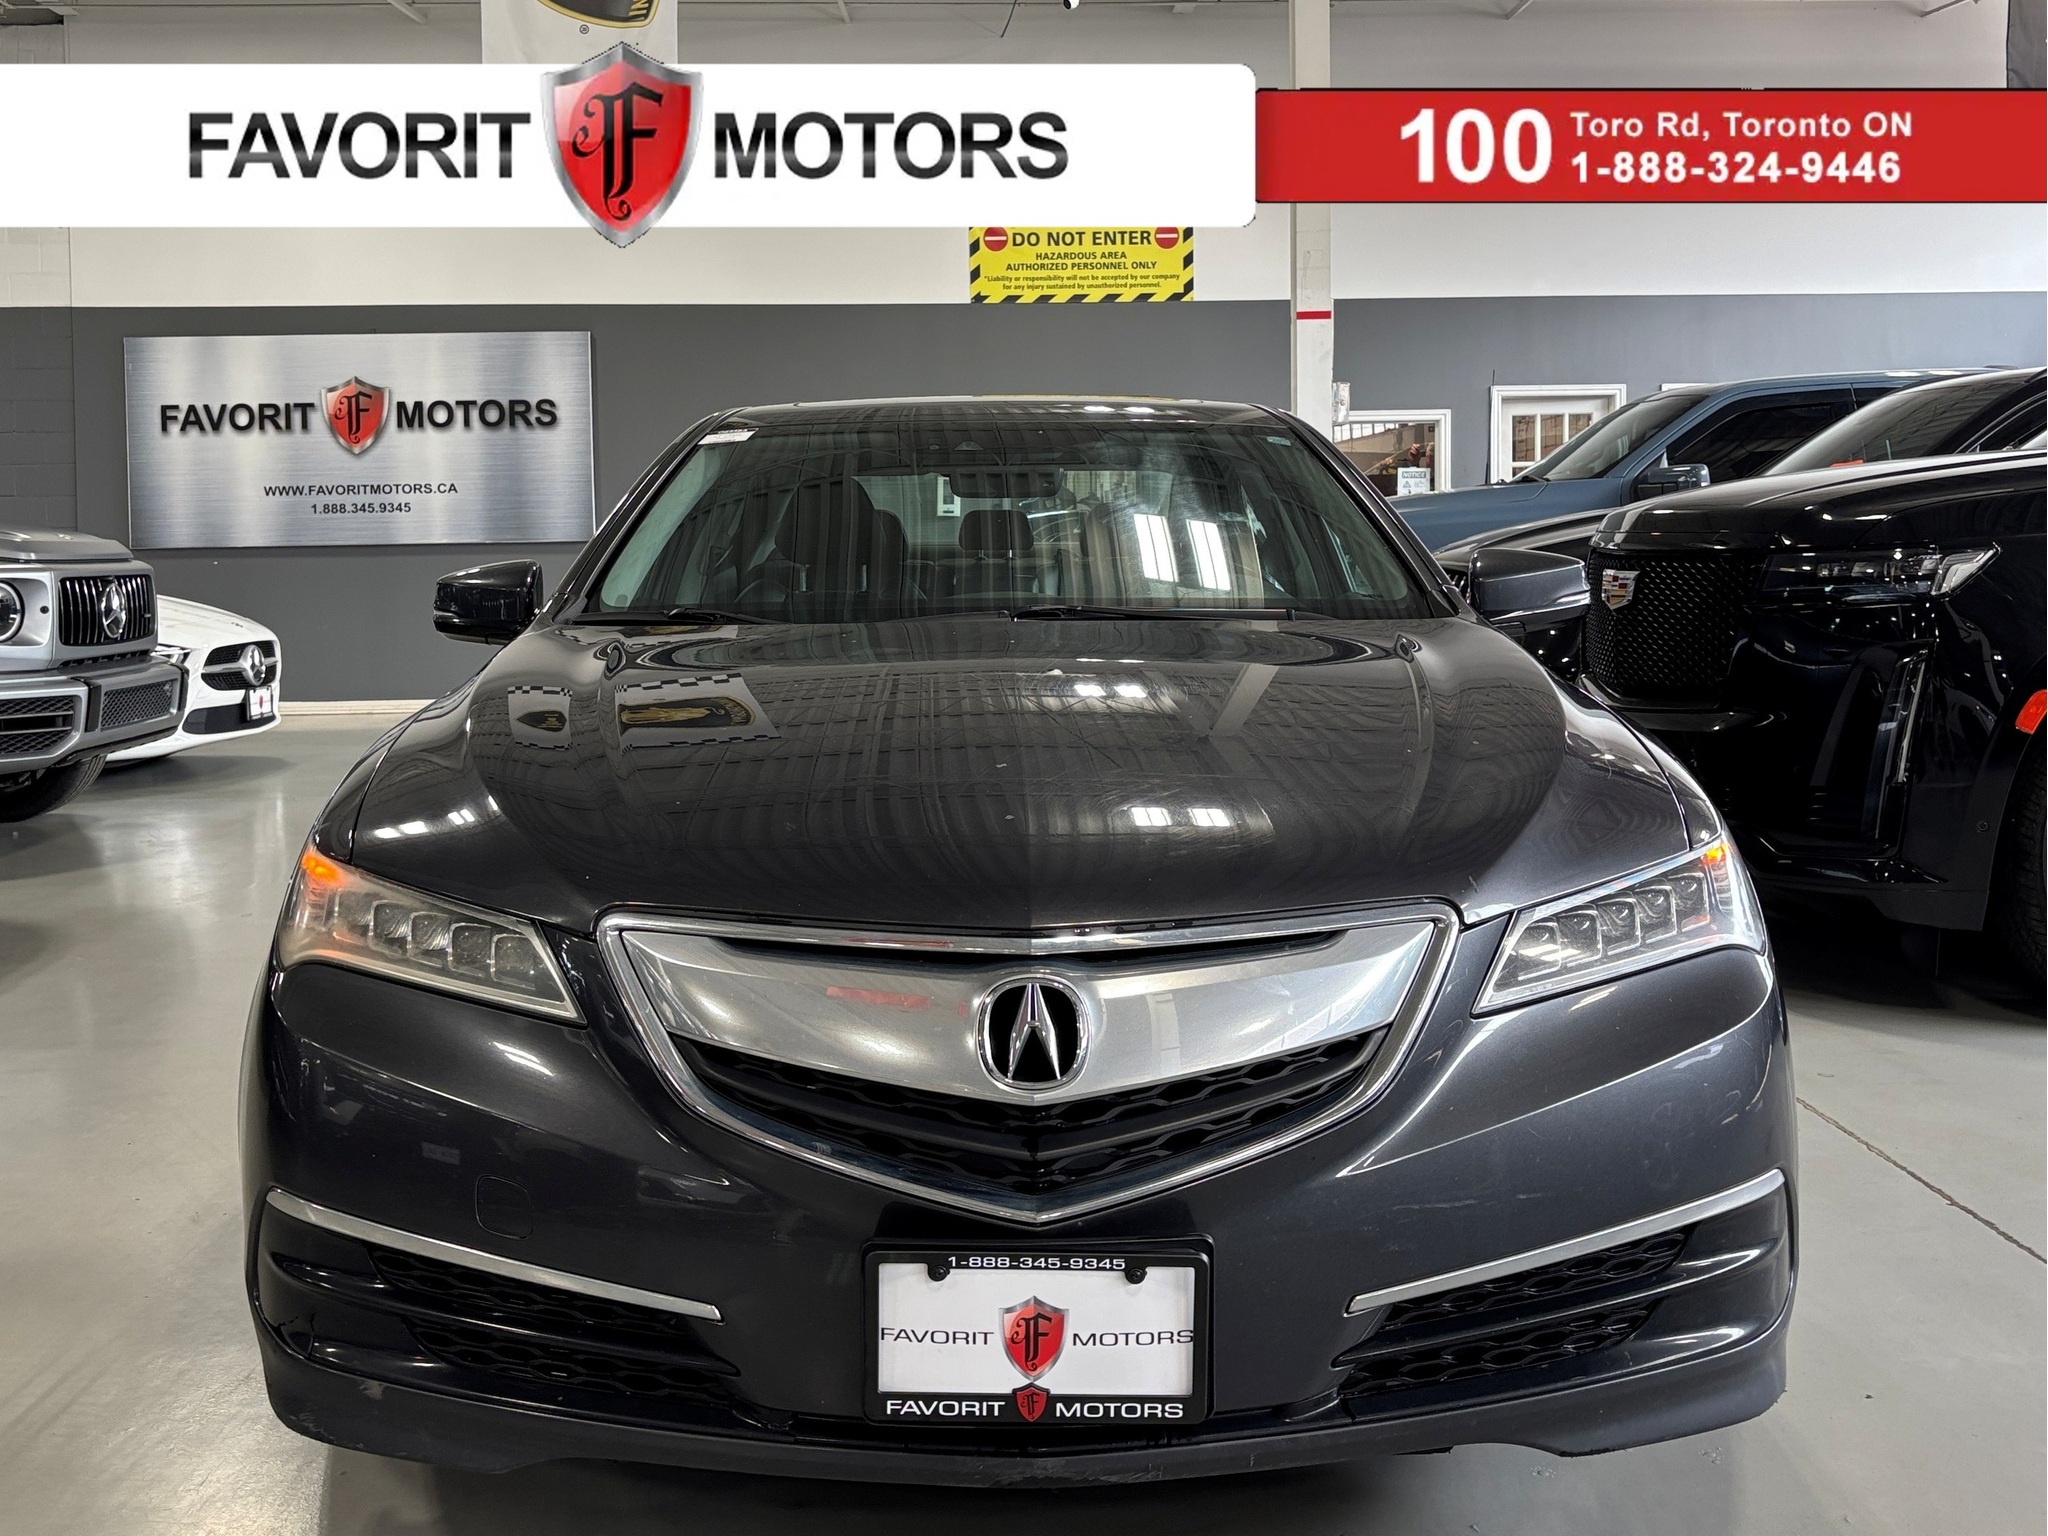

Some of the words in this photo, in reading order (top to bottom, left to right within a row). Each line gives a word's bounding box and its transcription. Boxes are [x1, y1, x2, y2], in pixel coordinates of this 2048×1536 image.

[1012, 231, 1040, 247] DO
[1047, 231, 1086, 247] NOT
[1092, 230, 1152, 246] ENTER
[1035, 252, 1097, 261] HAZARDOUS
[1100, 251, 1127, 260] AREA
[1006, 262, 1069, 271] AUTHORIZED
[1071, 262, 1129, 271] PERSONNEL
[1132, 261, 1157, 270] ONLY
[1022, 274, 1064, 282] responsibility
[1101, 274, 1129, 282] accepted
[1027, 283, 1044, 291] injury
[1077, 282, 1085, 290] by
[1086, 281, 1128, 289] unauthorized
[160, 402, 315, 433] FAVORIT
[396, 398, 558, 429] MOTORS
[263, 483, 458, 497] WWW.FAVORITMOTORS.CA
[311, 502, 412, 515] 1.888.345.9345
[948, 1256, 1126, 1270] 1-888-345-9345
[881, 1327, 994, 1345] FAVORIT
[1072, 1329, 1195, 1347] MOTORS
[886, 1400, 1006, 1417] FAVORIT
[1055, 1402, 1184, 1419] MOTORS
